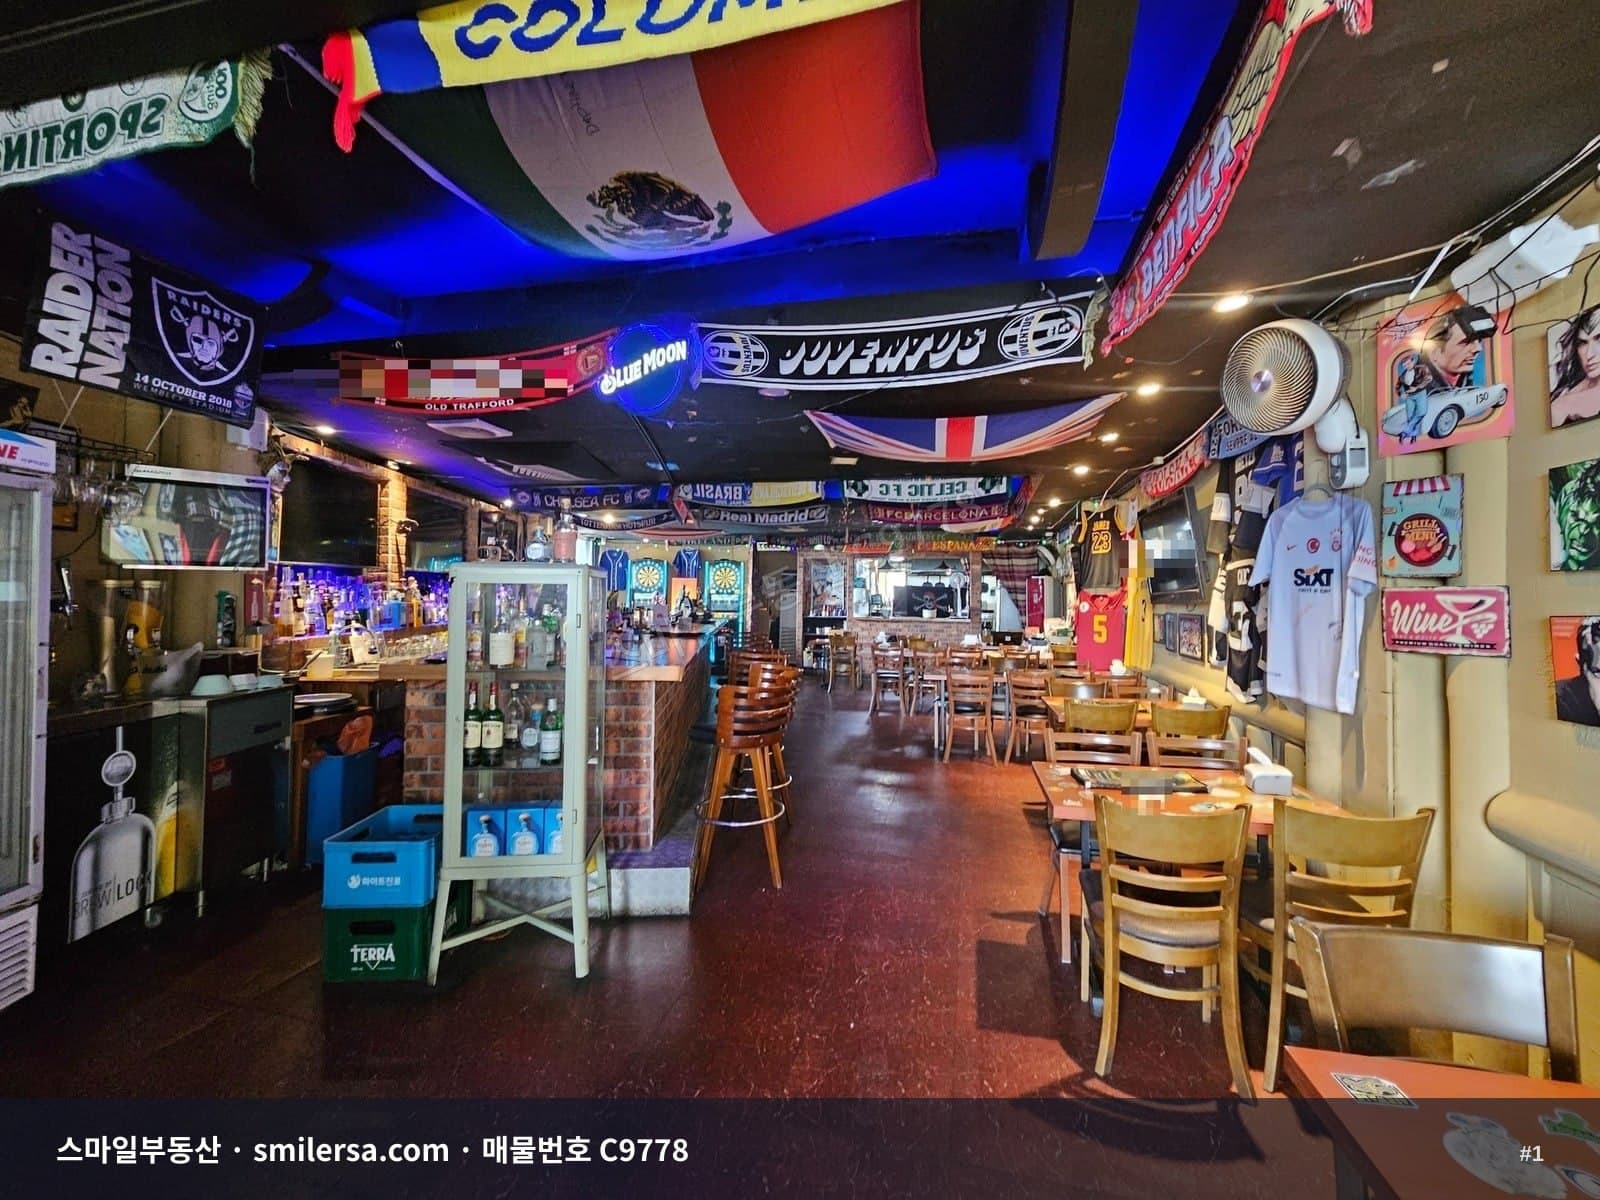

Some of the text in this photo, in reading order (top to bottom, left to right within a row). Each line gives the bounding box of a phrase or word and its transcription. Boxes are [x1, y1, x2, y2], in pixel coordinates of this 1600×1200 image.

[30, 221, 94, 379] RAIDER
[78, 234, 134, 390] NATION
[166, 289, 242, 328] RAIDERS
[778, 328, 987, 376] JUVENTUS
[1019, 315, 1035, 357] JUVENTUS
[600, 340, 687, 395] BLUE MOON
[740, 336, 752, 373] JUVENTUS
[133, 382, 231, 415] WEMBLEY STADIUM
[134, 372, 233, 409] 14 OCTOBER 2018
[424, 398, 514, 411] OLD TRAFFORD
[544, 493, 620, 508] CHLSEA FC
[720, 508, 809, 524] Real Madrid
[1403, 519, 1438, 530] GRILL
[1405, 531, 1437, 541] MENU
[1091, 530, 1112, 555] 23
[1093, 614, 1108, 644] 5
[1390, 599, 1456, 635] Wine
[350, 943, 396, 964] TERRA
